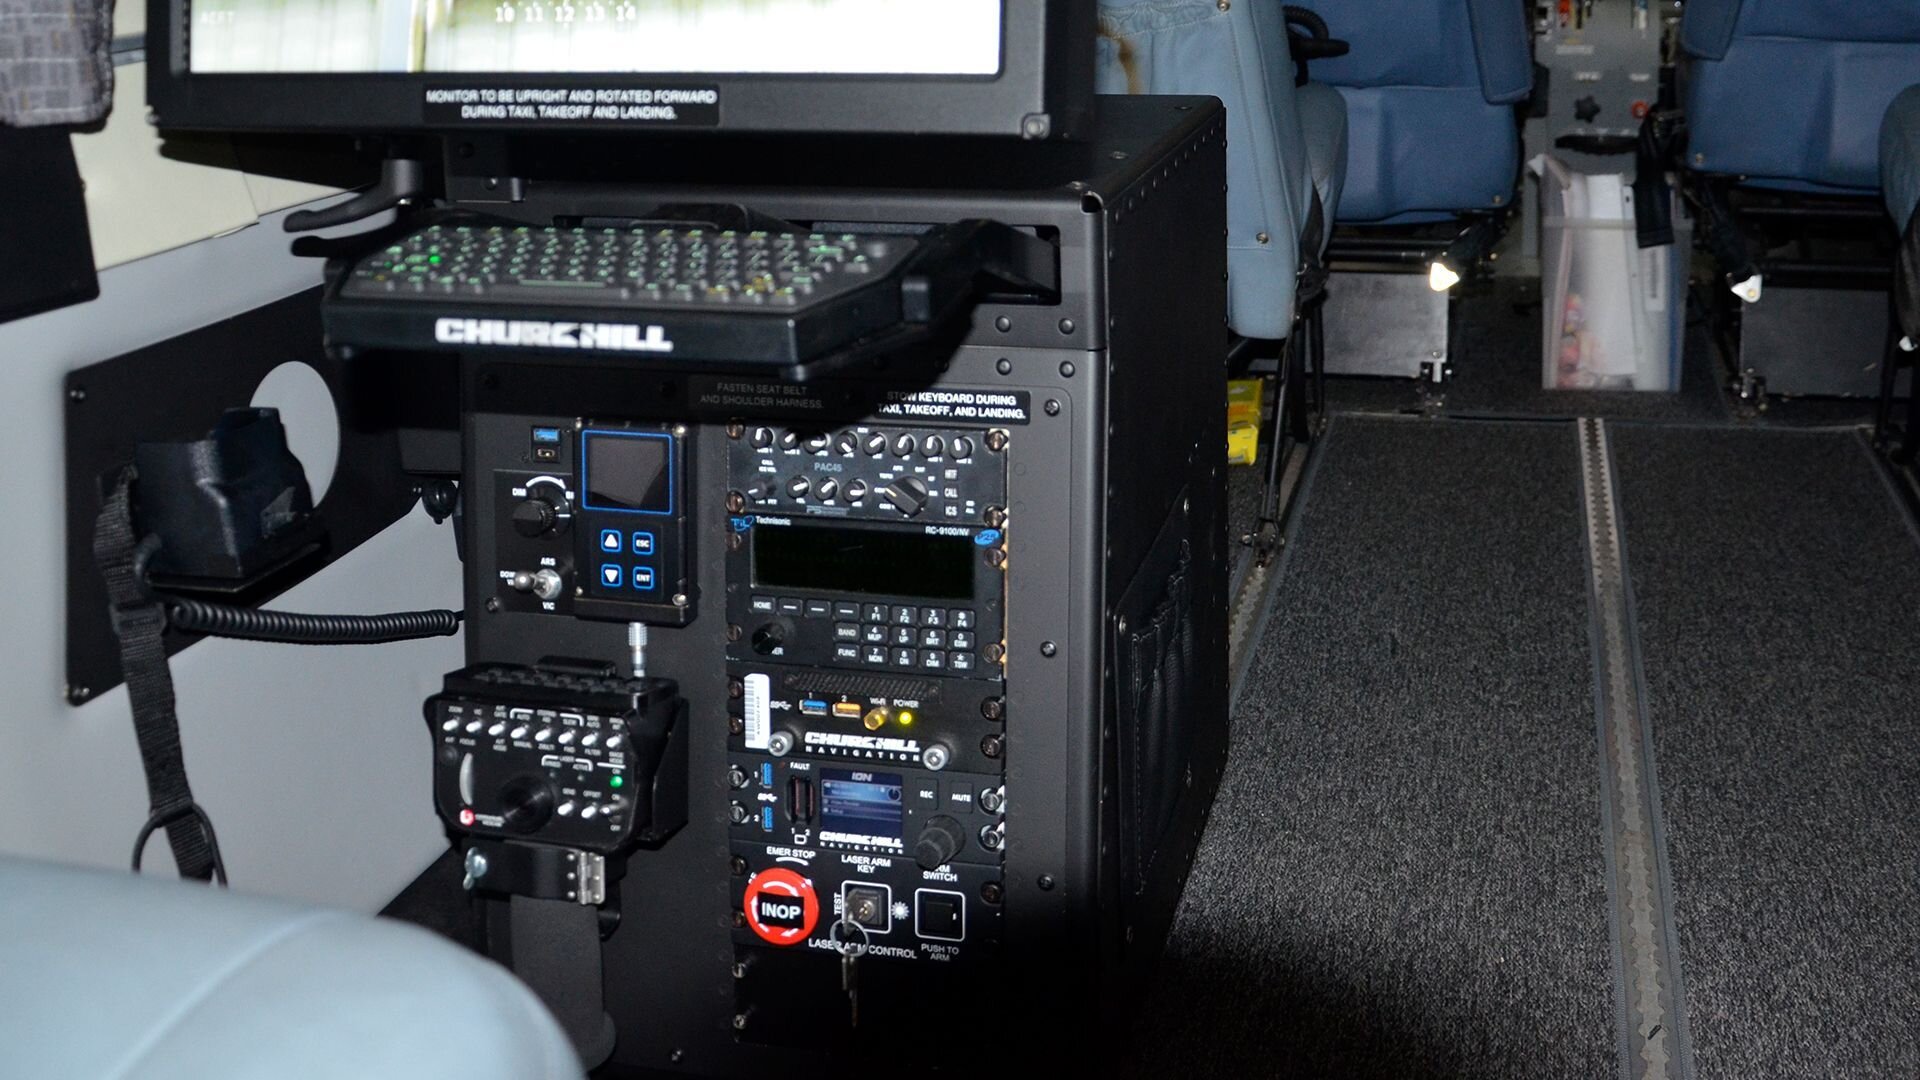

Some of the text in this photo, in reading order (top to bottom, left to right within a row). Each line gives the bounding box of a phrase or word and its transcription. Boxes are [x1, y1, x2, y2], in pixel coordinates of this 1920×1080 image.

[495, 5, 515, 23] 10
[525, 5, 543, 23] 11
[554, 5, 575, 23] 12
[615, 5, 636, 23] 14
[426, 89, 717, 104] MONITOR TO BE UPRIGHT AND ROTATED FORWARD
[461, 105, 507, 119] DURING
[538, 105, 592, 119] TAKEOFF
[593, 105, 619, 119] AND
[620, 106, 678, 120] LANDING.
[435, 318, 674, 352] CHURCHILL
[716, 382, 807, 396] FASTEN SEAT BELT
[700, 394, 720, 405] AND
[722, 395, 774, 407] SHOULDER
[887, 391, 1016, 406] STOW KEYBOARD DURING
[904, 404, 952, 417] TAKEOFF,
[955, 406, 977, 417] AND
[978, 407, 1026, 419] LANDING.
[814, 462, 842, 472] PAC45
[512, 488, 527, 497] DIM
[944, 487, 958, 498] CALL
[945, 506, 958, 516] ICS
[756, 515, 791, 526] Technisonic
[925, 525, 970, 537] RC-9100/NV
[636, 540, 650, 548] ESC
[540, 557, 556, 567] ARS
[500, 570, 516, 579] DOW
[636, 574, 651, 582] ENT
[542, 602, 556, 611] VIC
[753, 601, 772, 610] HOME
[871, 613, 880, 621] F1
[901, 608, 908, 616] 2
[930, 609, 937, 617] 3
[900, 615, 910, 624] F2
[928, 617, 938, 625] F3
[957, 620, 967, 628] F4
[838, 628, 856, 637] BAND
[899, 635, 909, 643] UP
[838, 648, 856, 657] FUNC
[926, 659, 940, 667] DIM
[841, 695, 848, 703] 2
[893, 699, 919, 709] POWER
[804, 731, 920, 753] CHURCHILL
[805, 745, 920, 762] NAVIGATION
[789, 762, 810, 770] FAULT
[851, 771, 873, 782] ION
[920, 790, 934, 799] REC
[951, 793, 971, 802] MUTE
[766, 846, 816, 859] EMER STOP
[820, 841, 904, 854] NAVIGATION
[841, 854, 892, 867] LASER ARM
[857, 865, 875, 873] KEY
[935, 864, 950, 873] RM
[923, 870, 958, 882] SWITCH
[834, 892, 842, 915] TEST
[761, 902, 801, 919] INOP
[808, 938, 842, 950] LASER
[868, 945, 917, 959] CONTROL
[921, 943, 959, 955] PUSH TO
[930, 952, 950, 961] ARM
